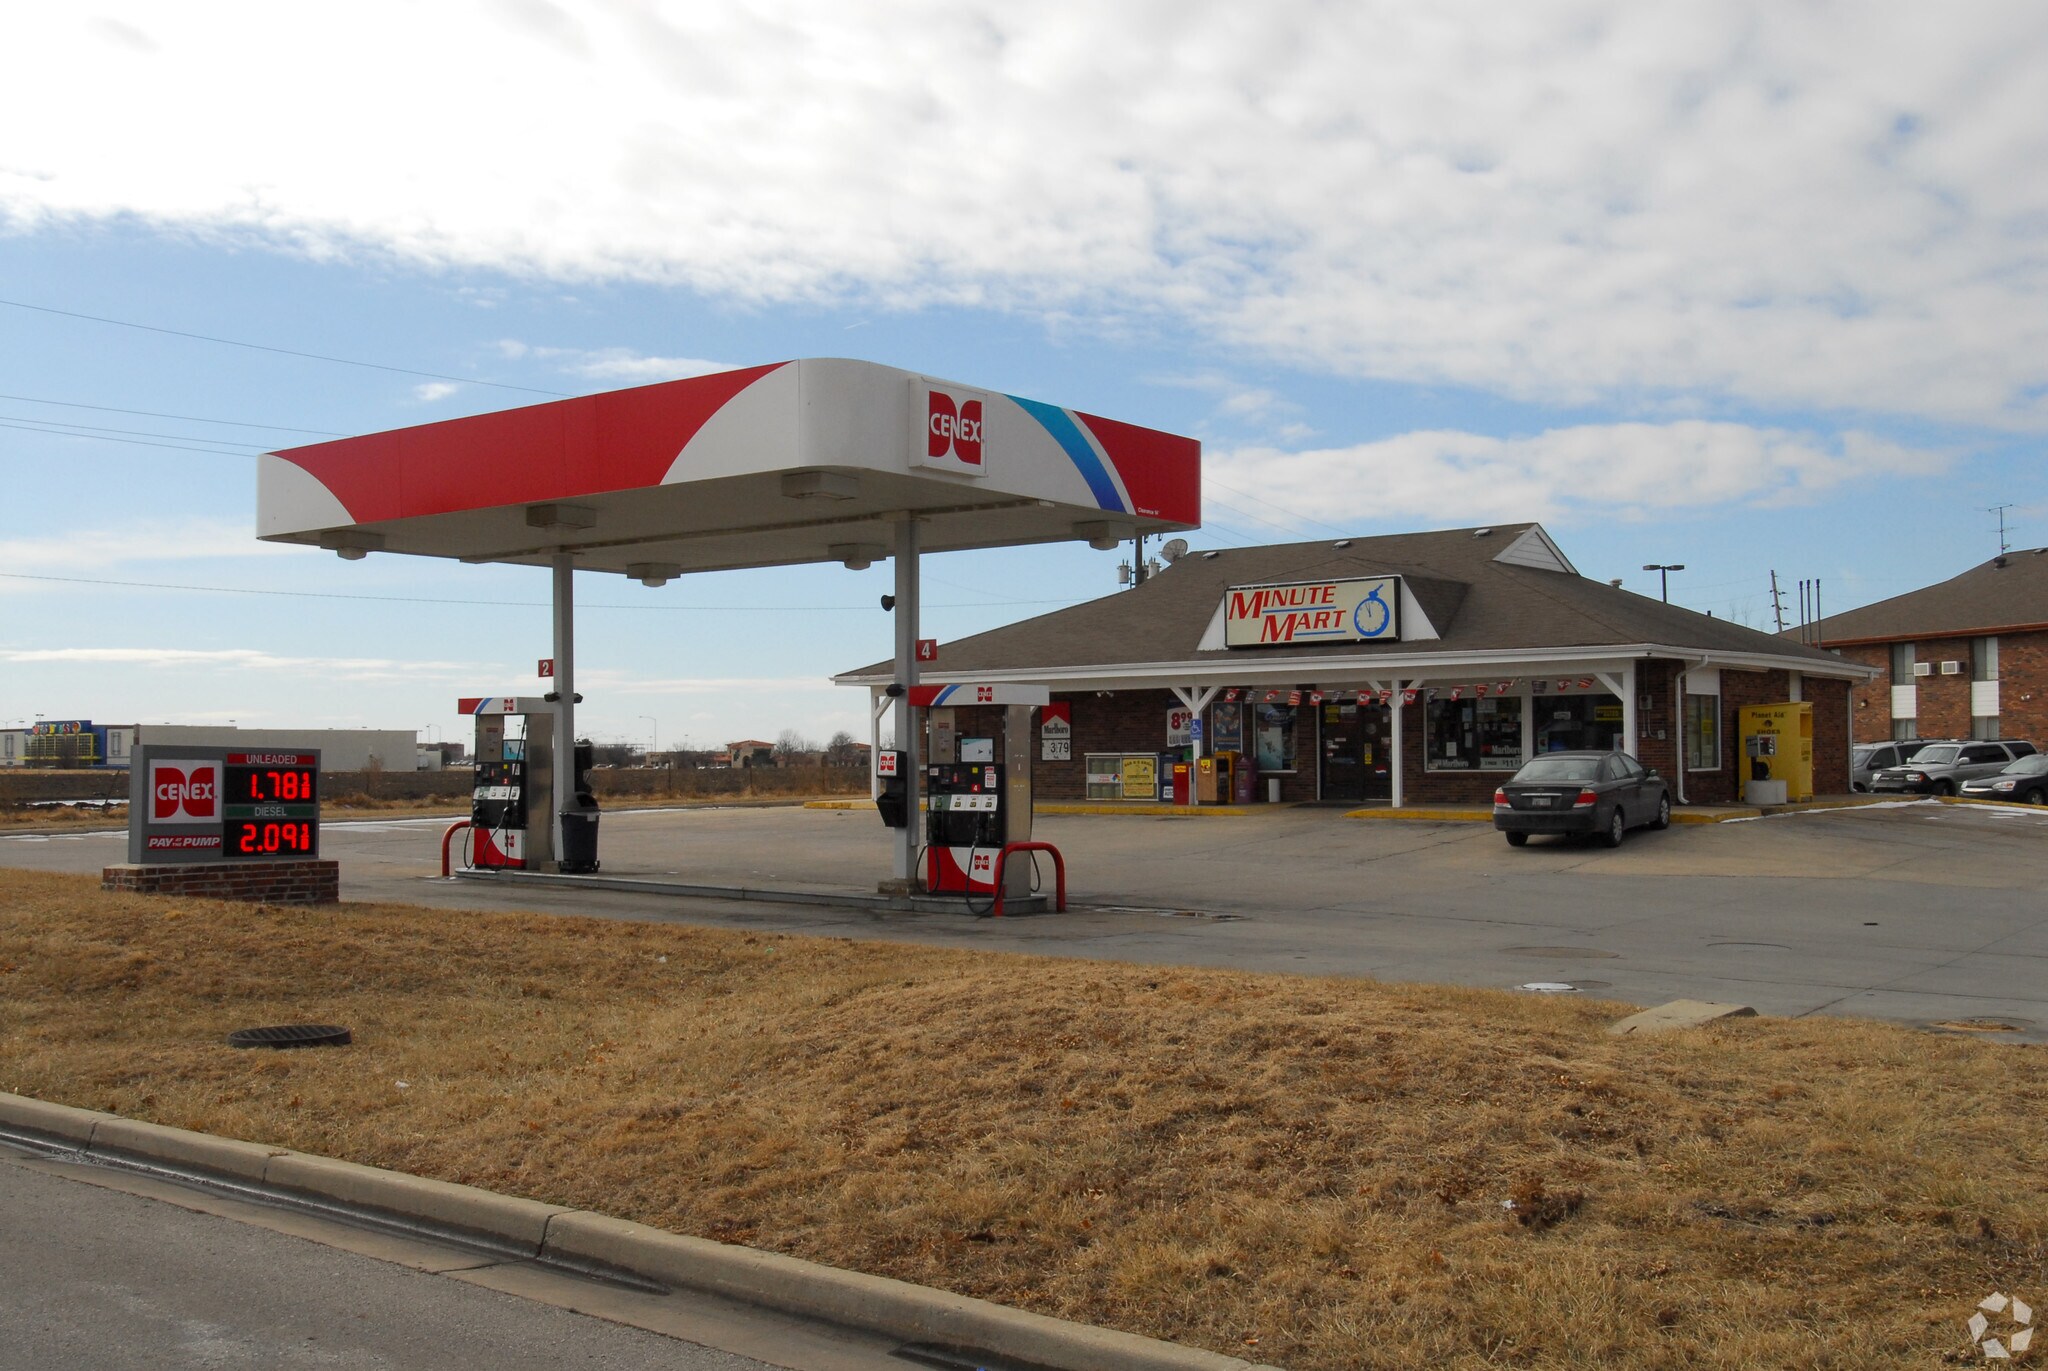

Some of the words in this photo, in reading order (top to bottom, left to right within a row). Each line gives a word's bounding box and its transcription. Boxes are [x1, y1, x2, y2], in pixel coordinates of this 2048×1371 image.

[930, 413, 982, 443] CENEX
[1228, 586, 1336, 620] MINUTE
[1260, 610, 1346, 643] MART
[921, 642, 931, 659] 4
[542, 661, 550, 675] 2
[1043, 723, 1069, 734] Marlboro
[246, 754, 298, 765] UNLEADED
[156, 783, 214, 801] CENEX
[973, 784, 979, 792] 4
[254, 806, 287, 817] DIESEL
[148, 837, 173, 848] PAY
[183, 837, 220, 847] PUMP
